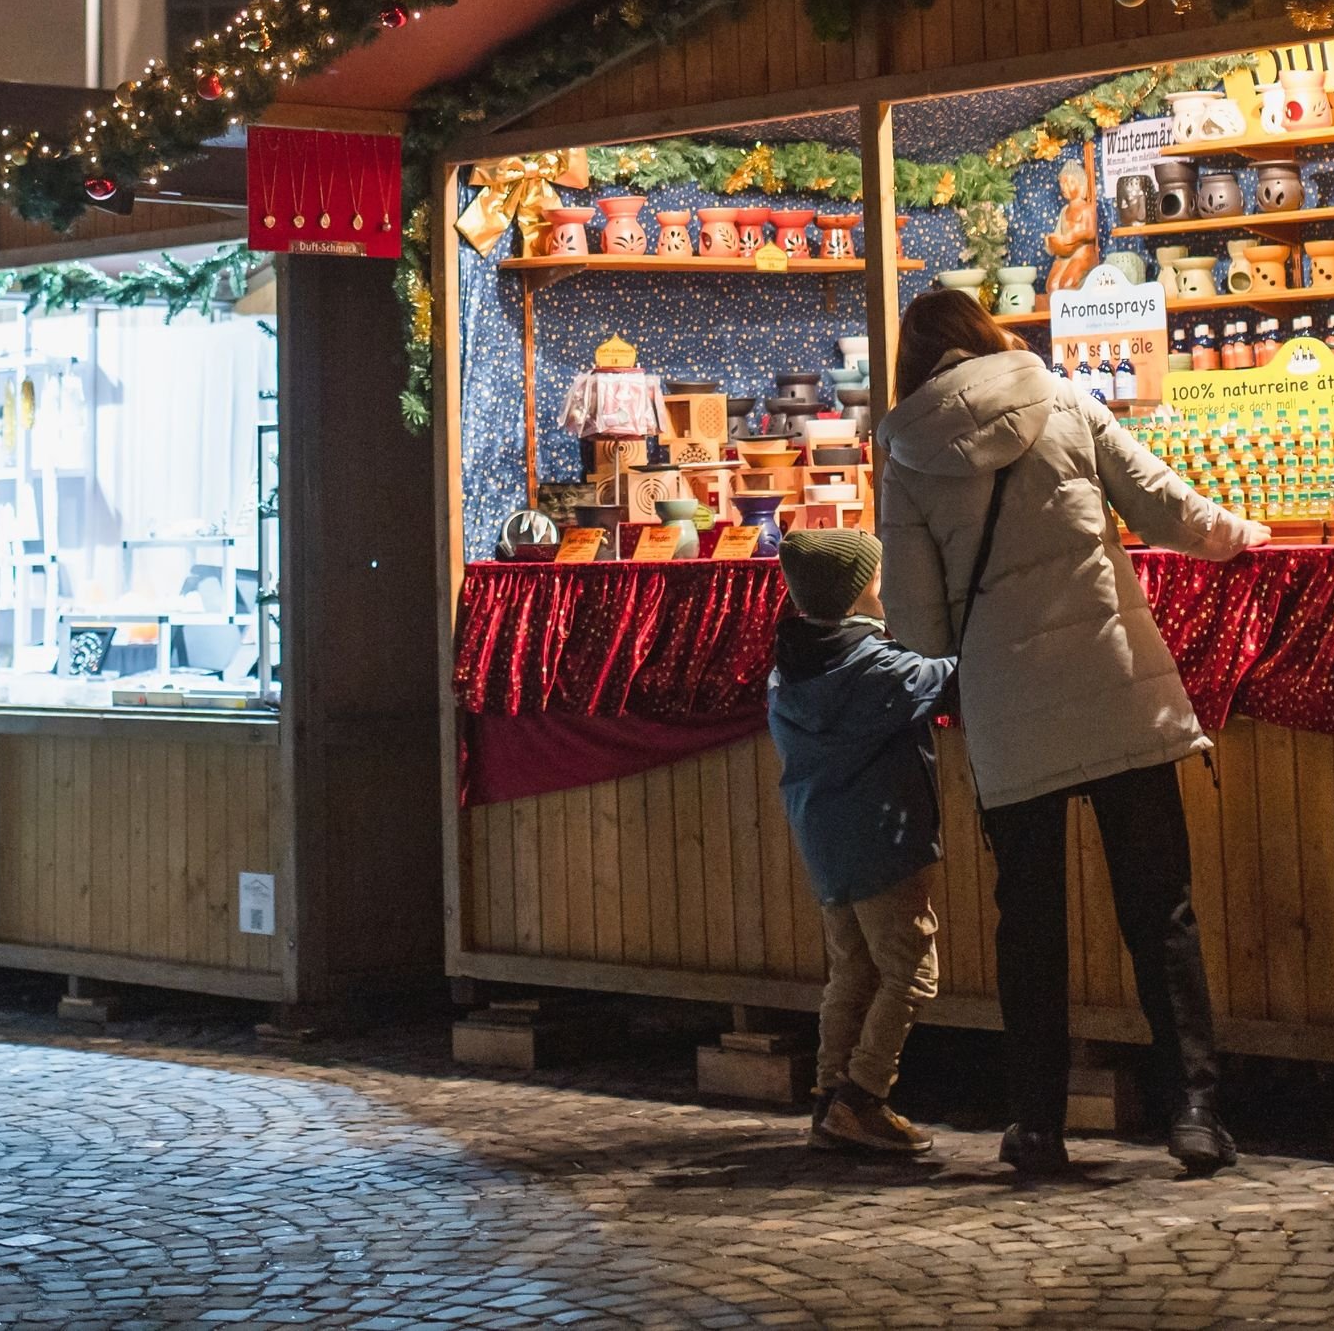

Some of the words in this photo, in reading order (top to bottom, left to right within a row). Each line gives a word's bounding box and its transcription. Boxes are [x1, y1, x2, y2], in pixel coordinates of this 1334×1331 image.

[1107, 122, 1179, 155] Wintermär
[299, 240, 358, 254] Duft-Schmuck
[1061, 299, 1156, 319] Aromasprays
[1172, 383, 1215, 401] 100%
[1223, 377, 1309, 398] naturreine
[1179, 403, 1225, 416] chmöcked
